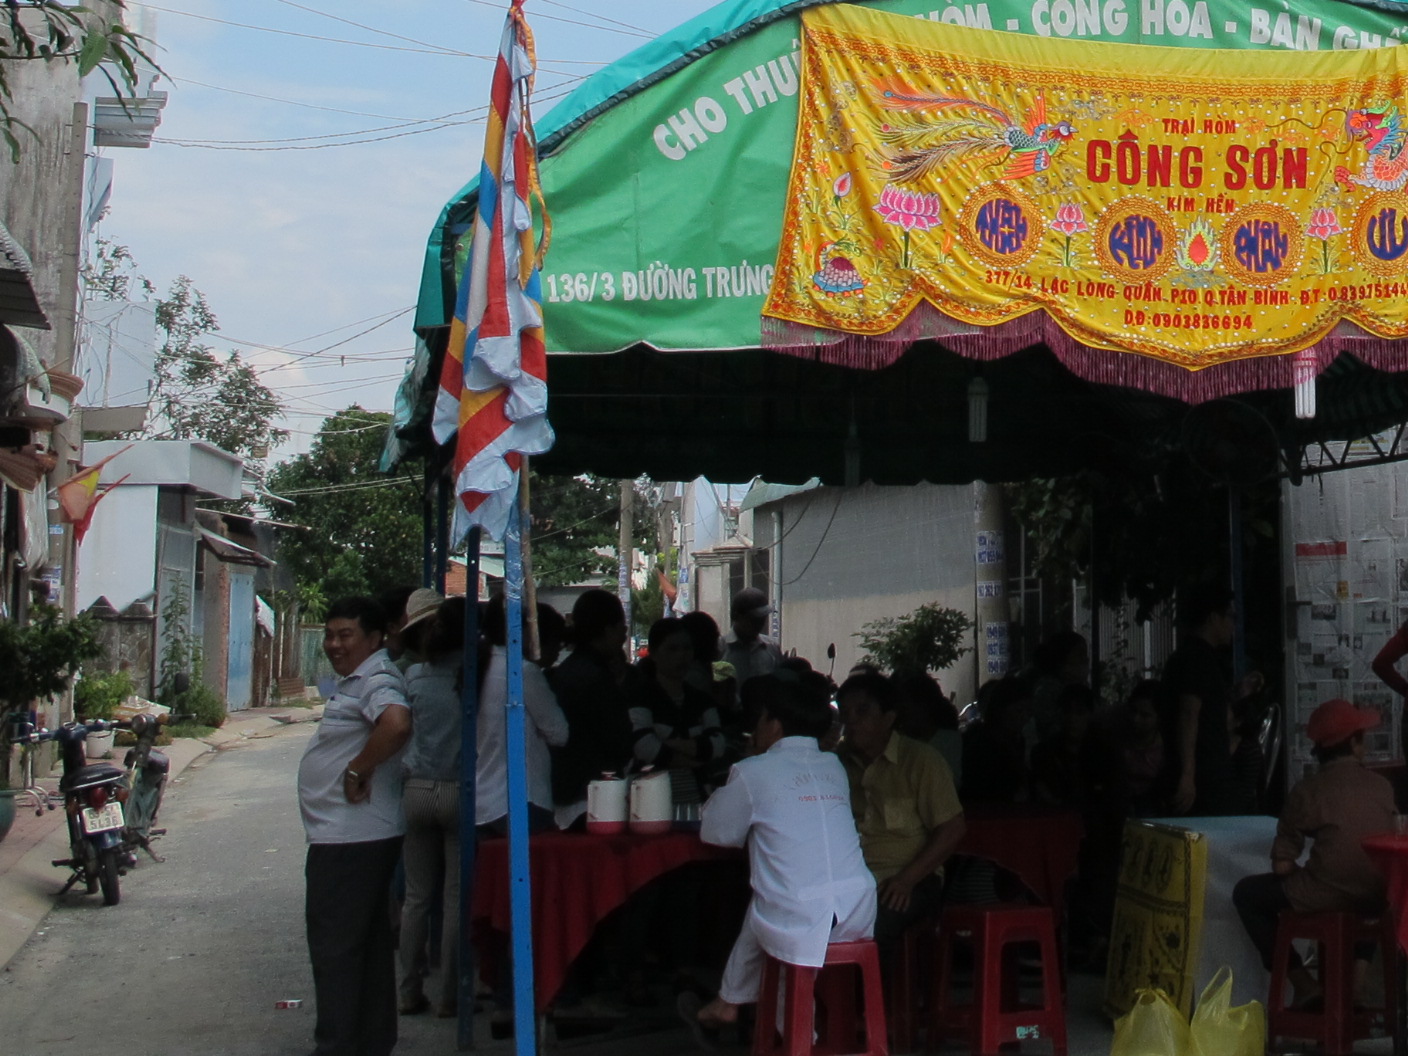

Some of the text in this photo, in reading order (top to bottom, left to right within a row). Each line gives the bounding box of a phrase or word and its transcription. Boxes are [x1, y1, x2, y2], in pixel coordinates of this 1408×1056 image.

[653, 96, 728, 161] CHO
[1250, 0, 1321, 51] BÀN
[1203, 114, 1237, 134] HÒM
[1086, 128, 1308, 190] CÔNG SƠN
[1167, 195, 1195, 212] KIM
[547, 271, 616, 303] 136/3
[622, 260, 697, 301] ĐƯỜNG
[985, 269, 1033, 291] 377/14
[1077, 281, 1116, 299] LONG
